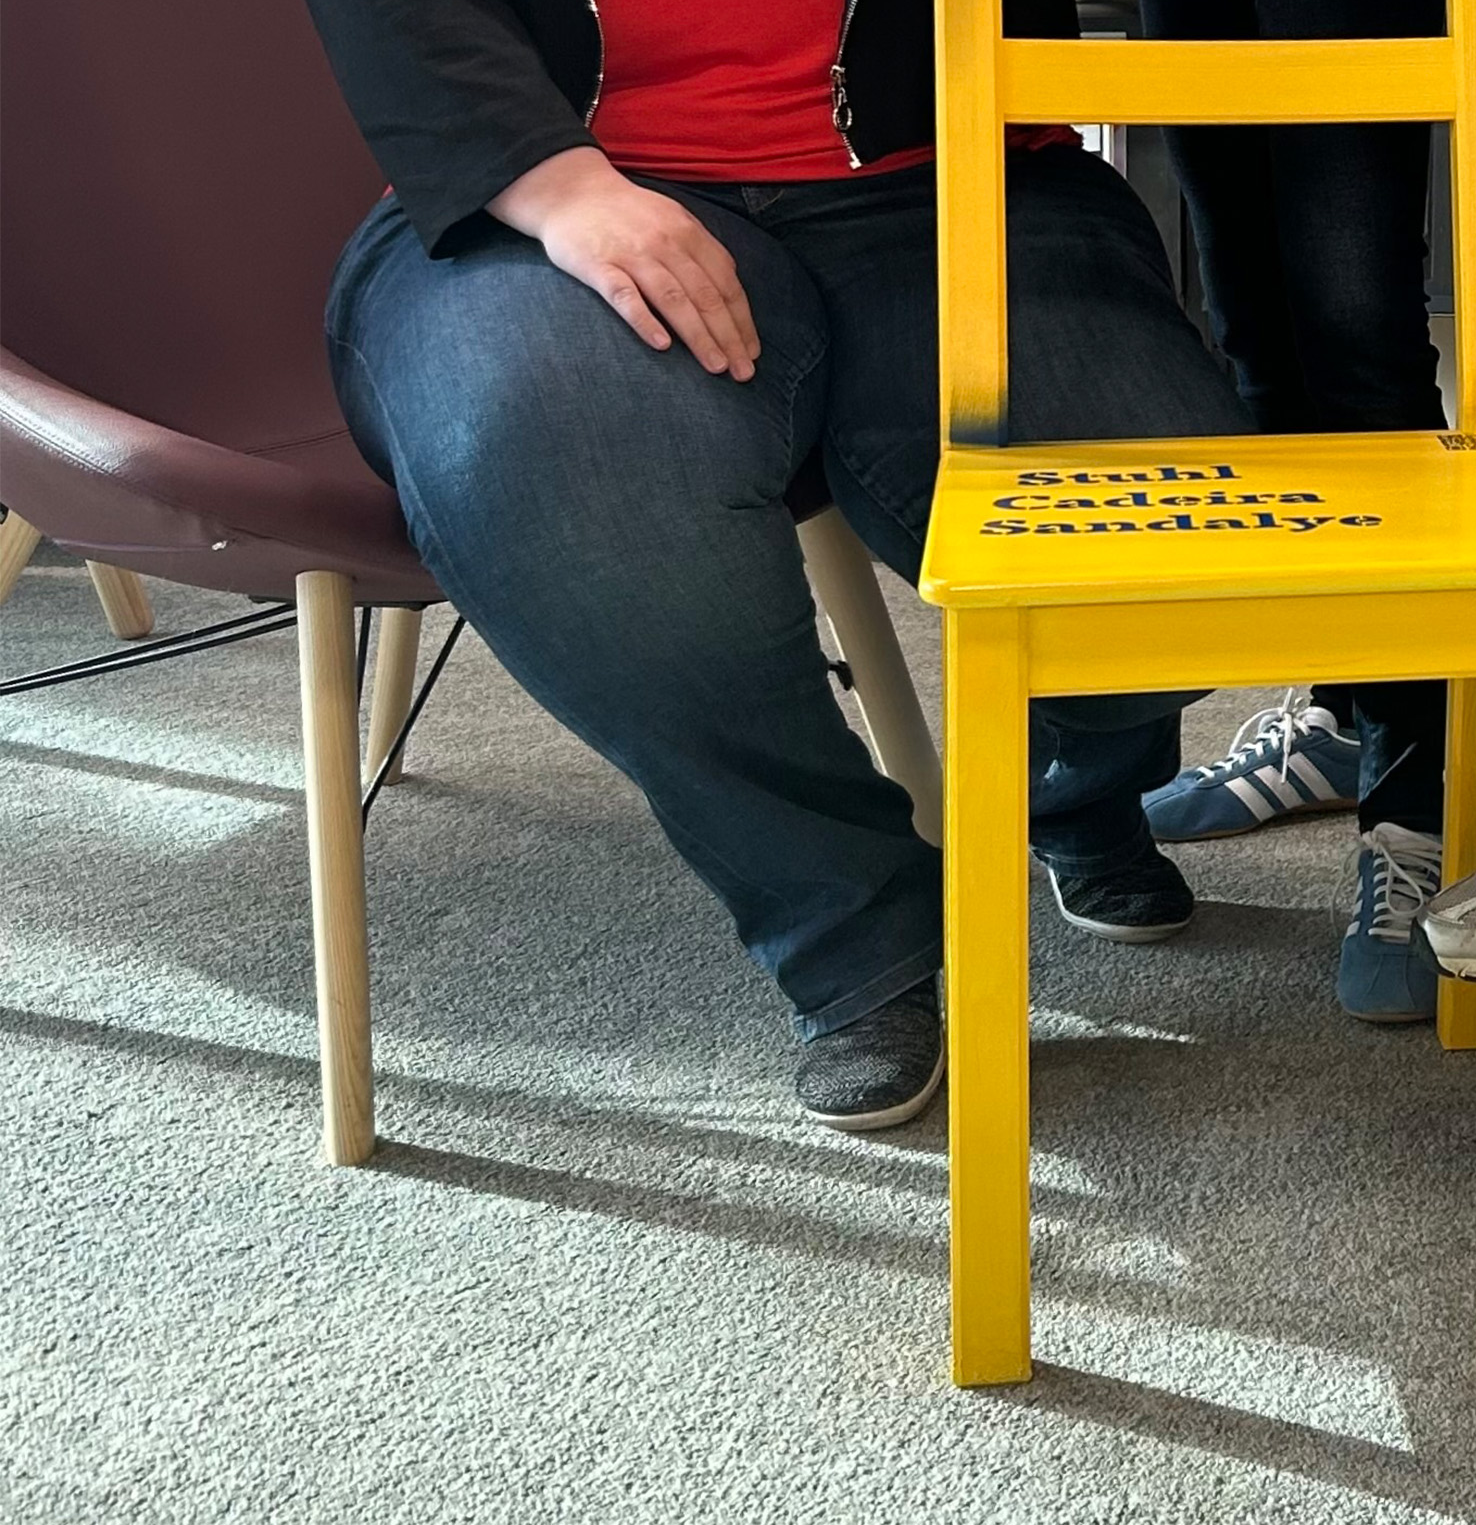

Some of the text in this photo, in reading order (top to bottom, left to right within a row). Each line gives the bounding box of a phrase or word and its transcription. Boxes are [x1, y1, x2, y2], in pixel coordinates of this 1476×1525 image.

[1017, 464, 1242, 486] Stuhl
[993, 491, 1326, 510] Cadeira
[979, 513, 1382, 535] Sandalye
